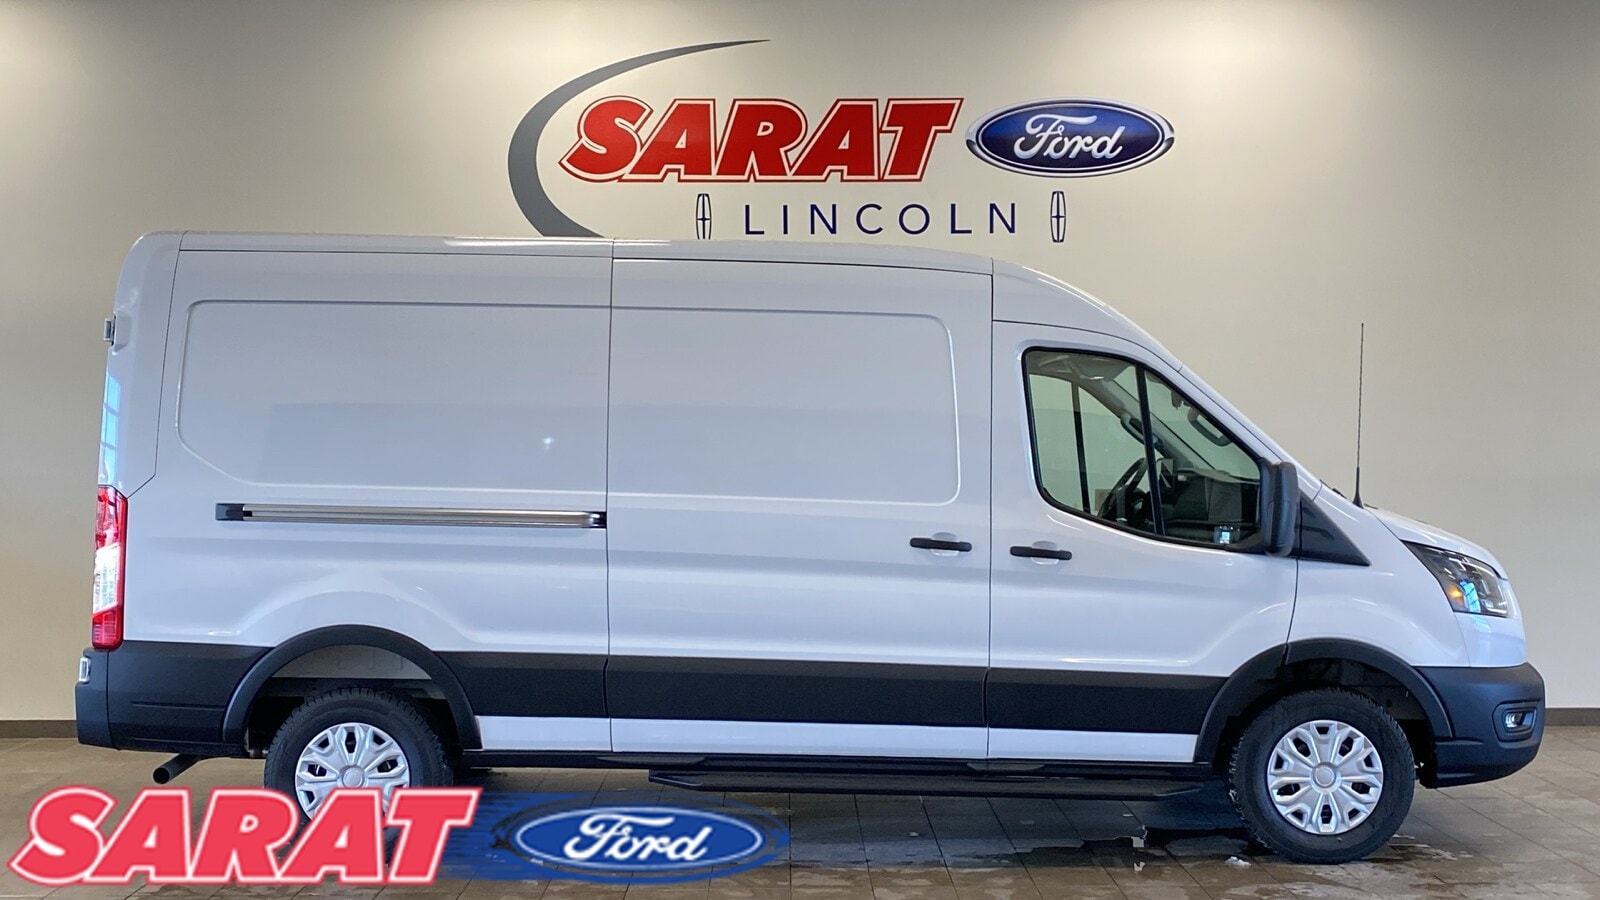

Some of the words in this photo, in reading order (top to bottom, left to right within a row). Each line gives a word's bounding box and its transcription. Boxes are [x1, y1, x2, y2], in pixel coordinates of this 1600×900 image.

[559, 96, 963, 183] SARAT
[1013, 114, 1124, 160] Ford
[744, 203, 1016, 235] LINCOLN
